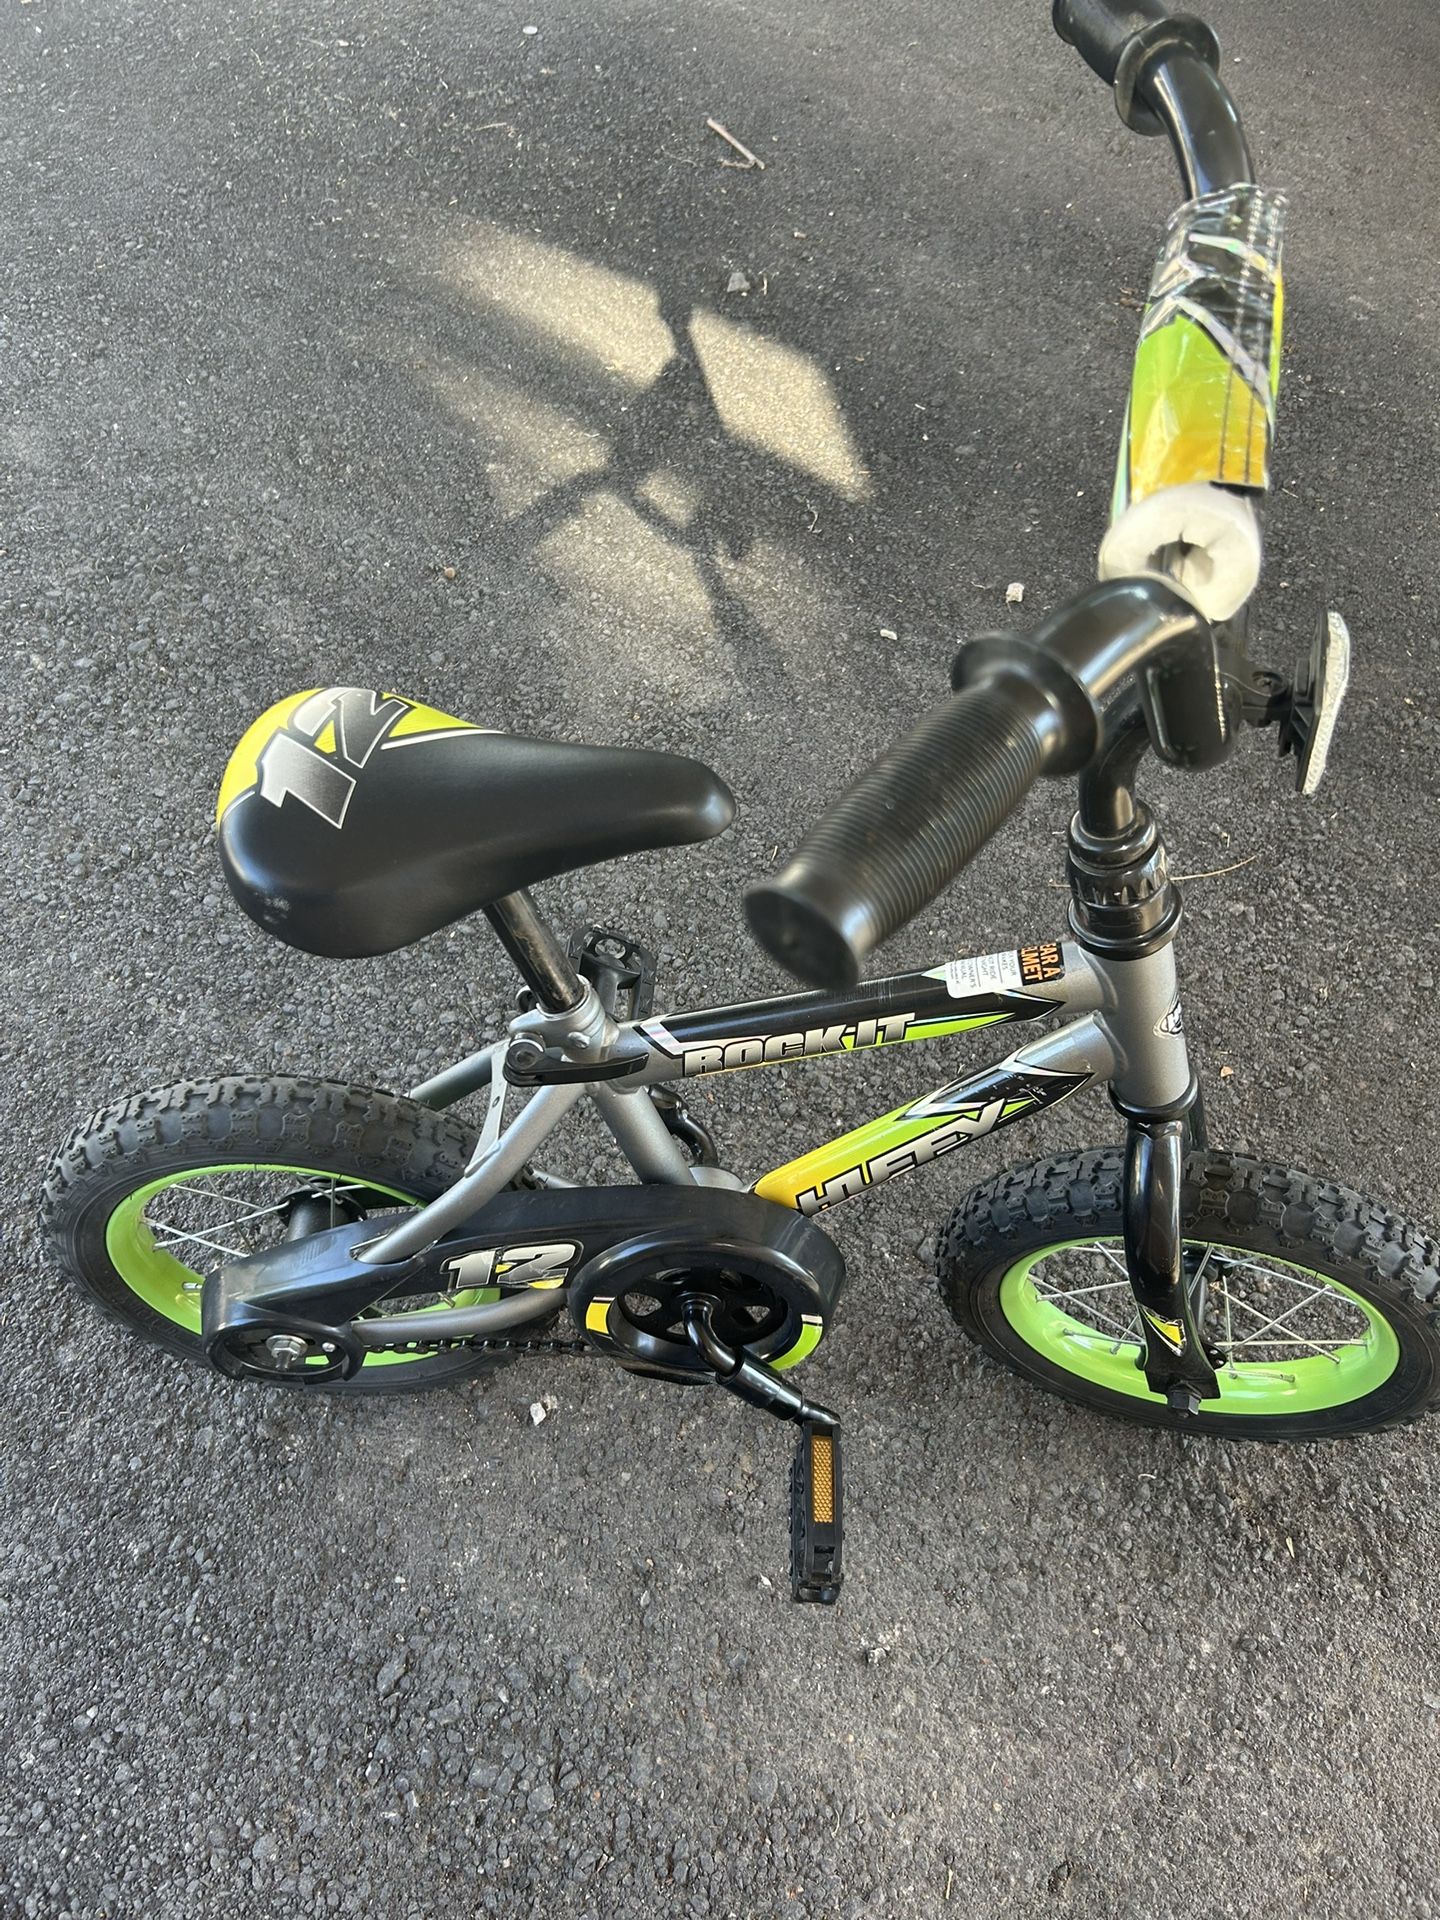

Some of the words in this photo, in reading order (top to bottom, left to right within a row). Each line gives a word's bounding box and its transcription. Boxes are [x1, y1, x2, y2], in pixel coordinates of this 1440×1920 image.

[260, 687, 408, 829] 12
[1040, 943, 1058, 965] EAR
[1043, 967, 1061, 978] A
[798, 1098, 1006, 1217] HUFFY
[448, 1244, 576, 1288] 12
